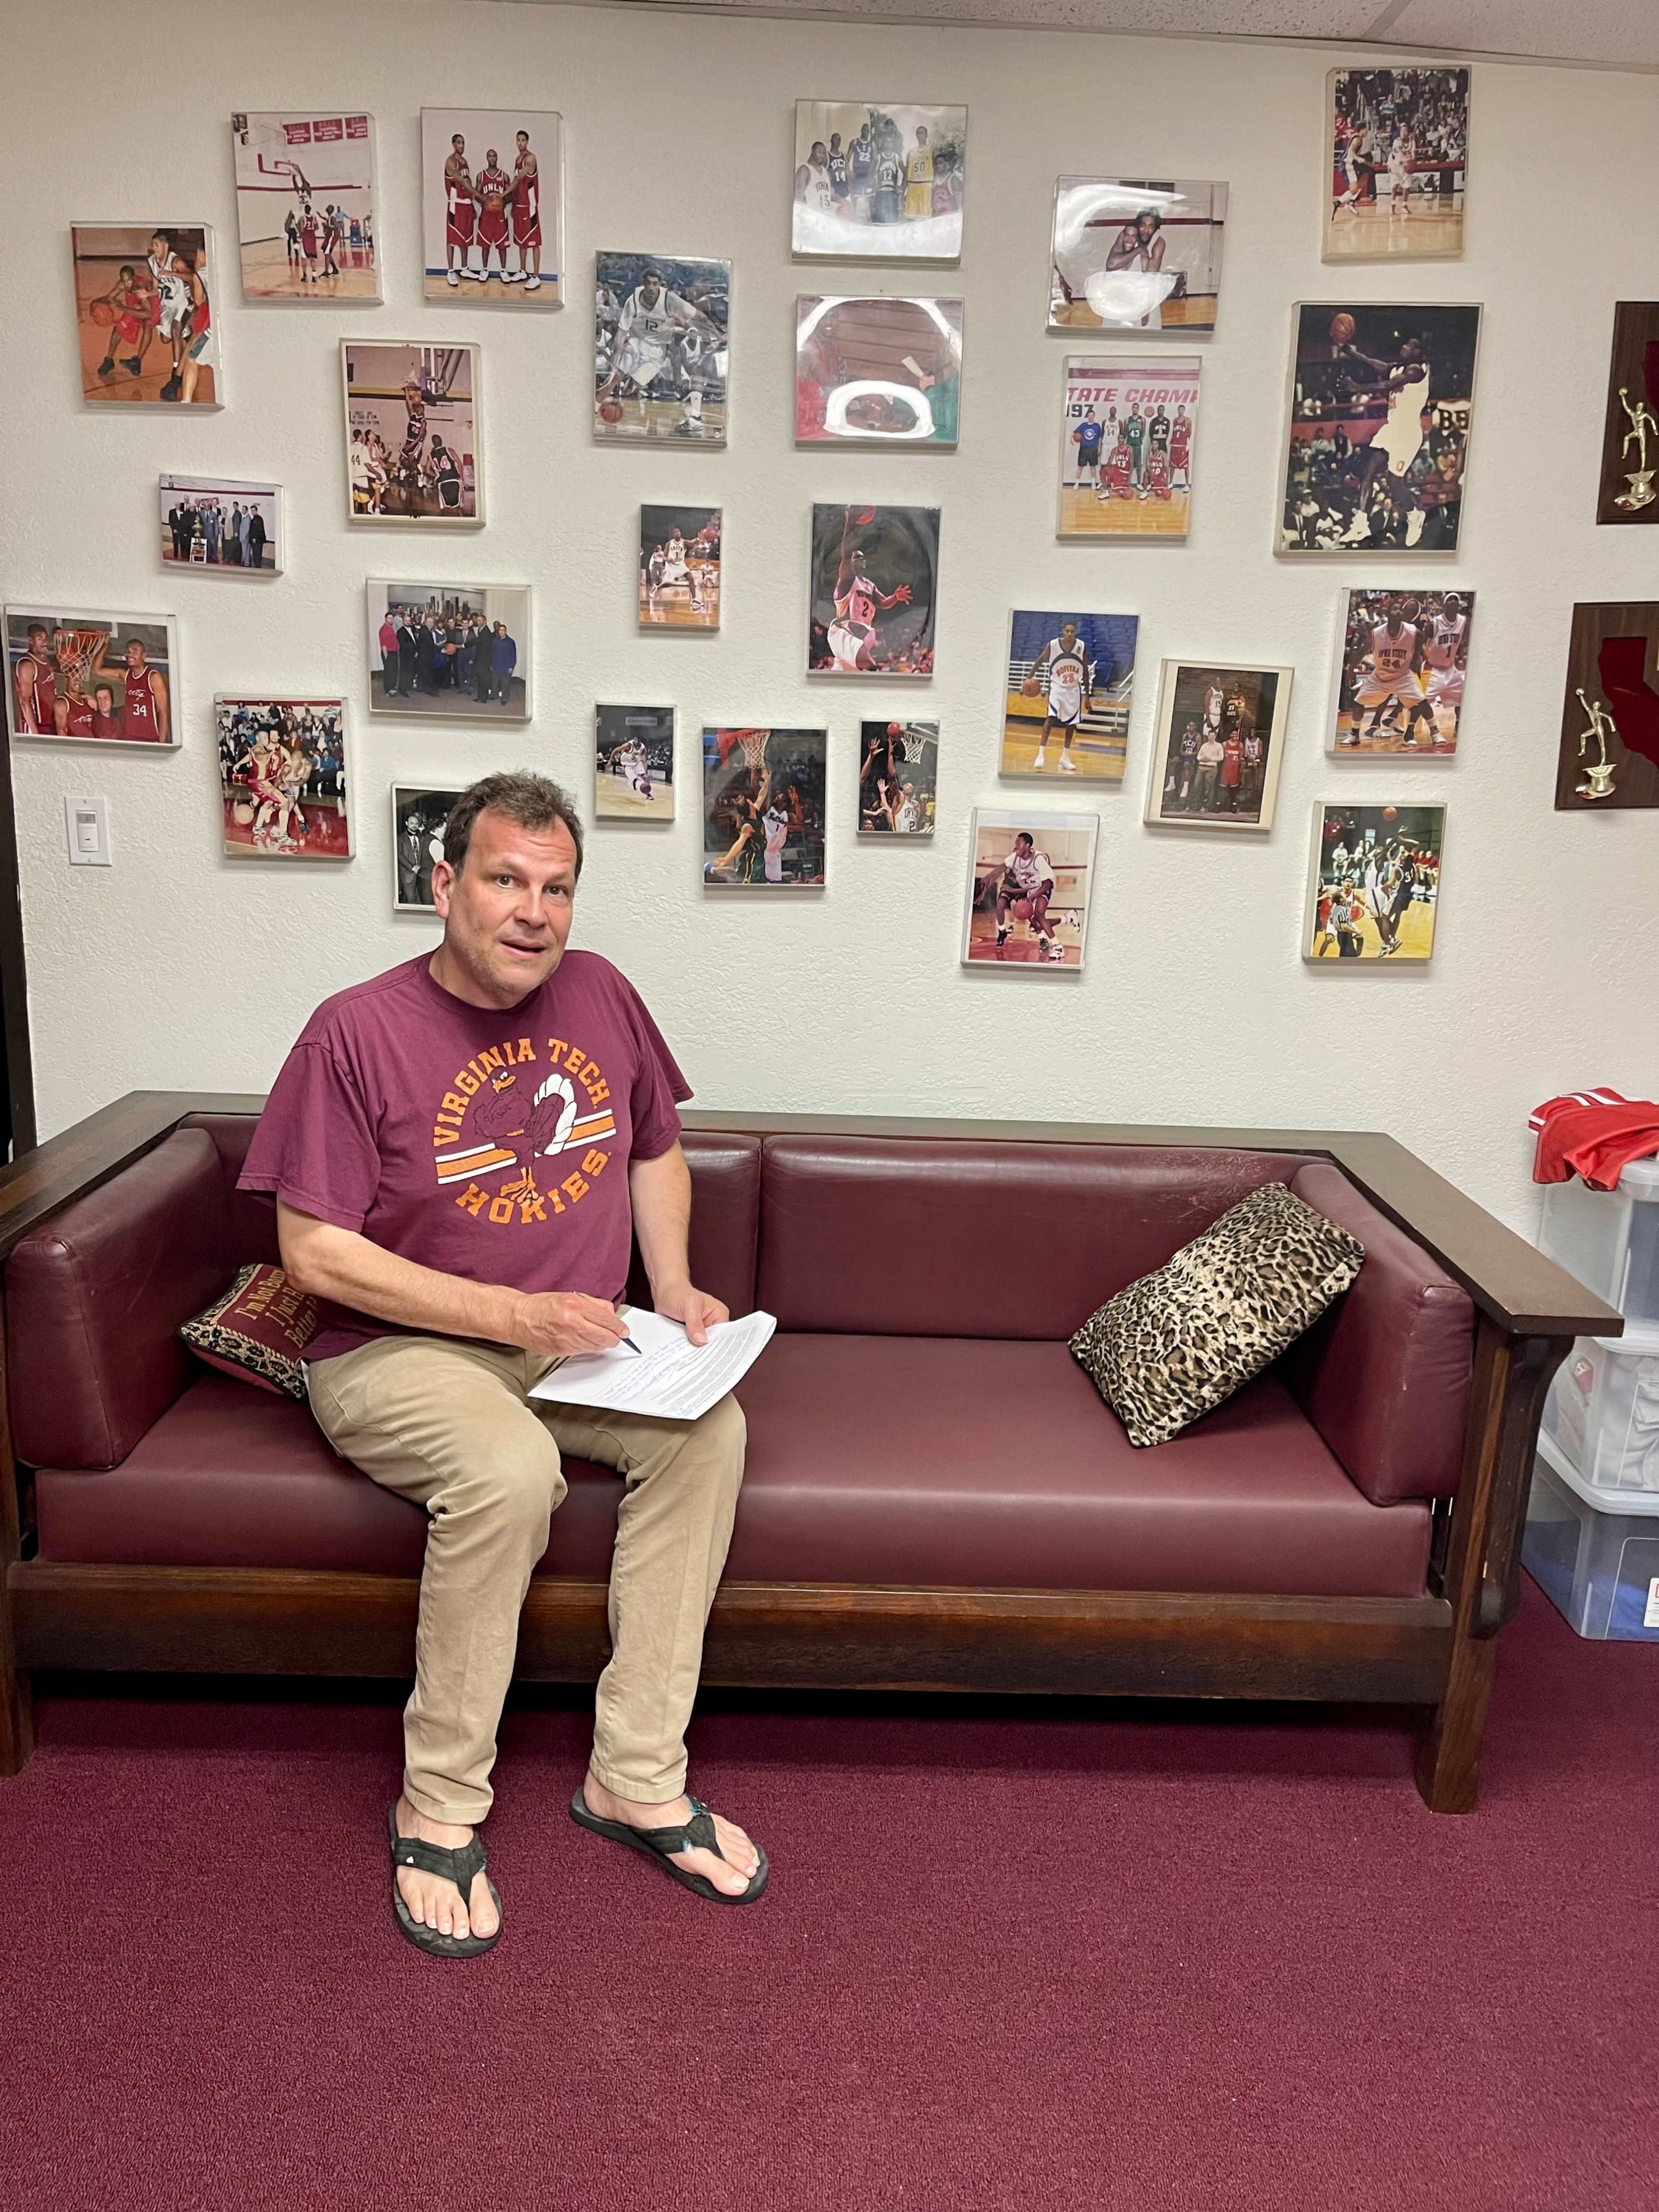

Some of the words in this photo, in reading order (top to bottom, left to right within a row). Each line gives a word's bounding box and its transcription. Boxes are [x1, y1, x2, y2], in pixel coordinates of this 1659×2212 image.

[914, 162, 925, 172] 50
[835, 172, 845, 181] 14
[884, 170, 893, 180] 12
[483, 183, 503, 194] UNLV
[645, 319, 658, 332] 12
[1130, 429, 1140, 438] 43
[351, 454, 361, 465] 44
[861, 601, 869, 618] 2
[133, 704, 147, 717] 34
[909, 821, 915, 832] 2
[433, 1038, 536, 1147] VIRGINIA
[548, 1038, 610, 1105] TECH
[455, 1149, 609, 1224] HOKIES
[247, 1287, 277, 1303] Not
[234, 1302, 266, 1320] I'm
[265, 1312, 286, 1327] I
[283, 1310, 318, 1349] Better
